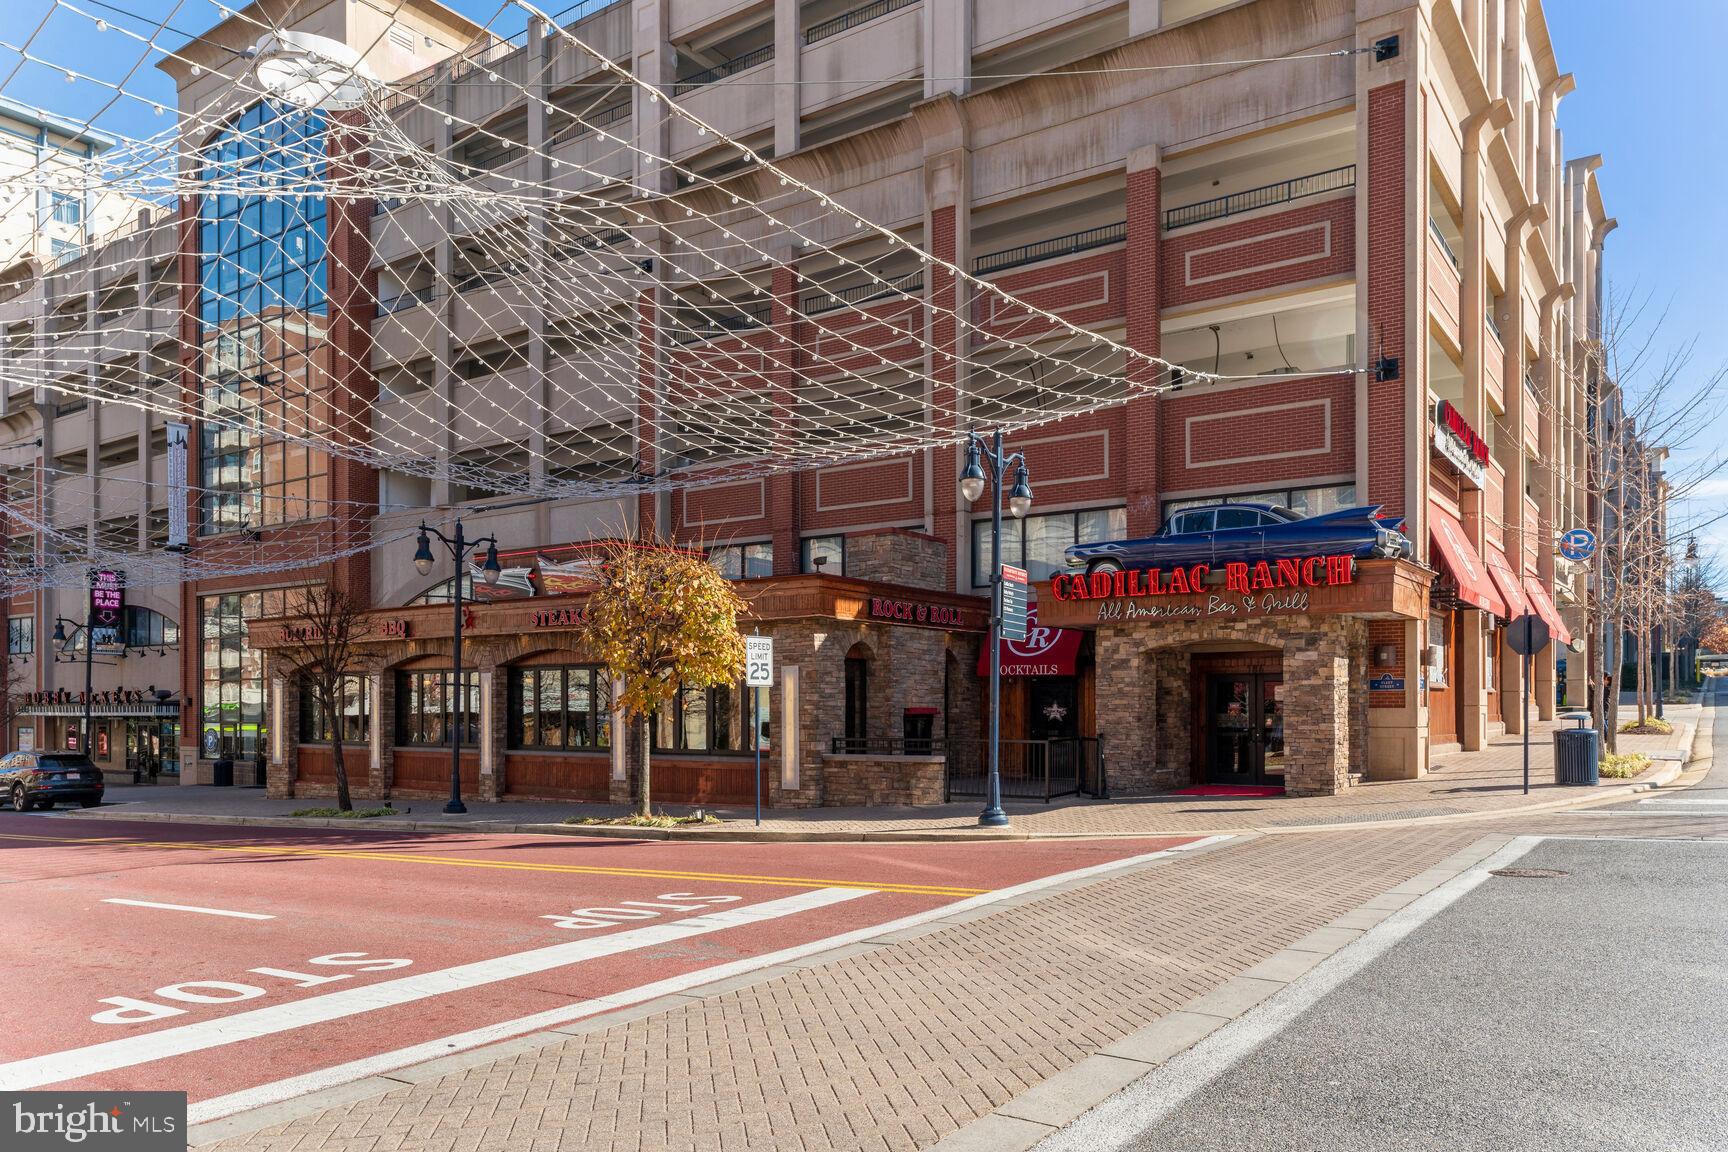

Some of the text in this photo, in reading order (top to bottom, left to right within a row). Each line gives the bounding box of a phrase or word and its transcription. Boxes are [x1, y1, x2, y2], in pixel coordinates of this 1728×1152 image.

[1050, 555, 1354, 601] CADILLAC RANCH
[94, 590, 120, 599] BE THE
[95, 598, 119, 607] PLACE
[872, 598, 964, 626] ROCK & ROLL
[1098, 602, 1123, 620] All
[1126, 601, 1202, 619] American
[1207, 595, 1239, 614] Bar
[1261, 592, 1309, 614] Grill
[381, 620, 406, 640] BBQ
[748, 642, 771, 651] SPEED
[750, 652, 768, 661] LIMIT
[750, 662, 770, 681] 25
[1000, 664, 1058, 676] OCKTAILS
[538, 892, 743, 929] STOP
[90, 952, 414, 1024] STOP
